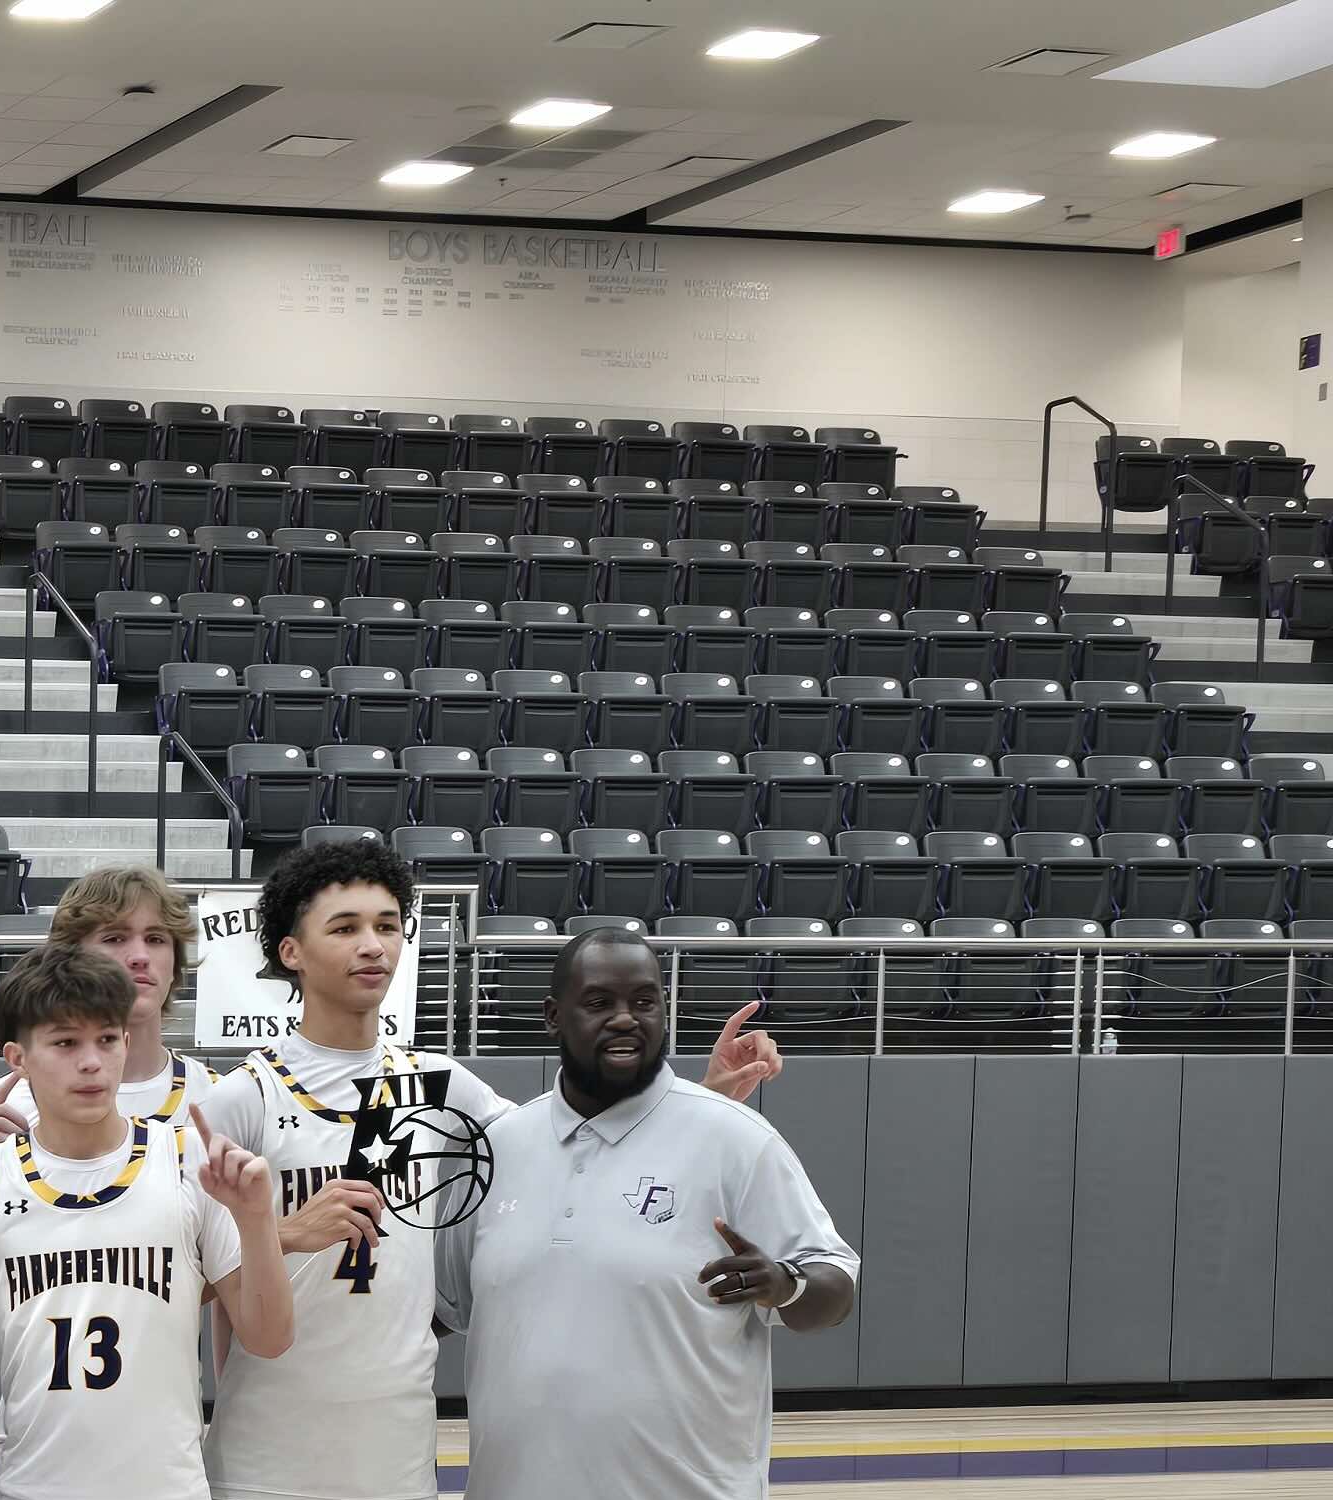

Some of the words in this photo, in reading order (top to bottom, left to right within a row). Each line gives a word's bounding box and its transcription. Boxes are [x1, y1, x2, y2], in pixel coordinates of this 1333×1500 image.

[388, 229, 470, 265] BOYS
[483, 234, 667, 273] BASKETBALL
[221, 1014, 279, 1038] EATS
[638, 1185, 669, 1216] F
[4, 1246, 174, 1312] FARMERSVILLE
[332, 1234, 378, 1294] 4
[46, 1314, 123, 1391] 13
